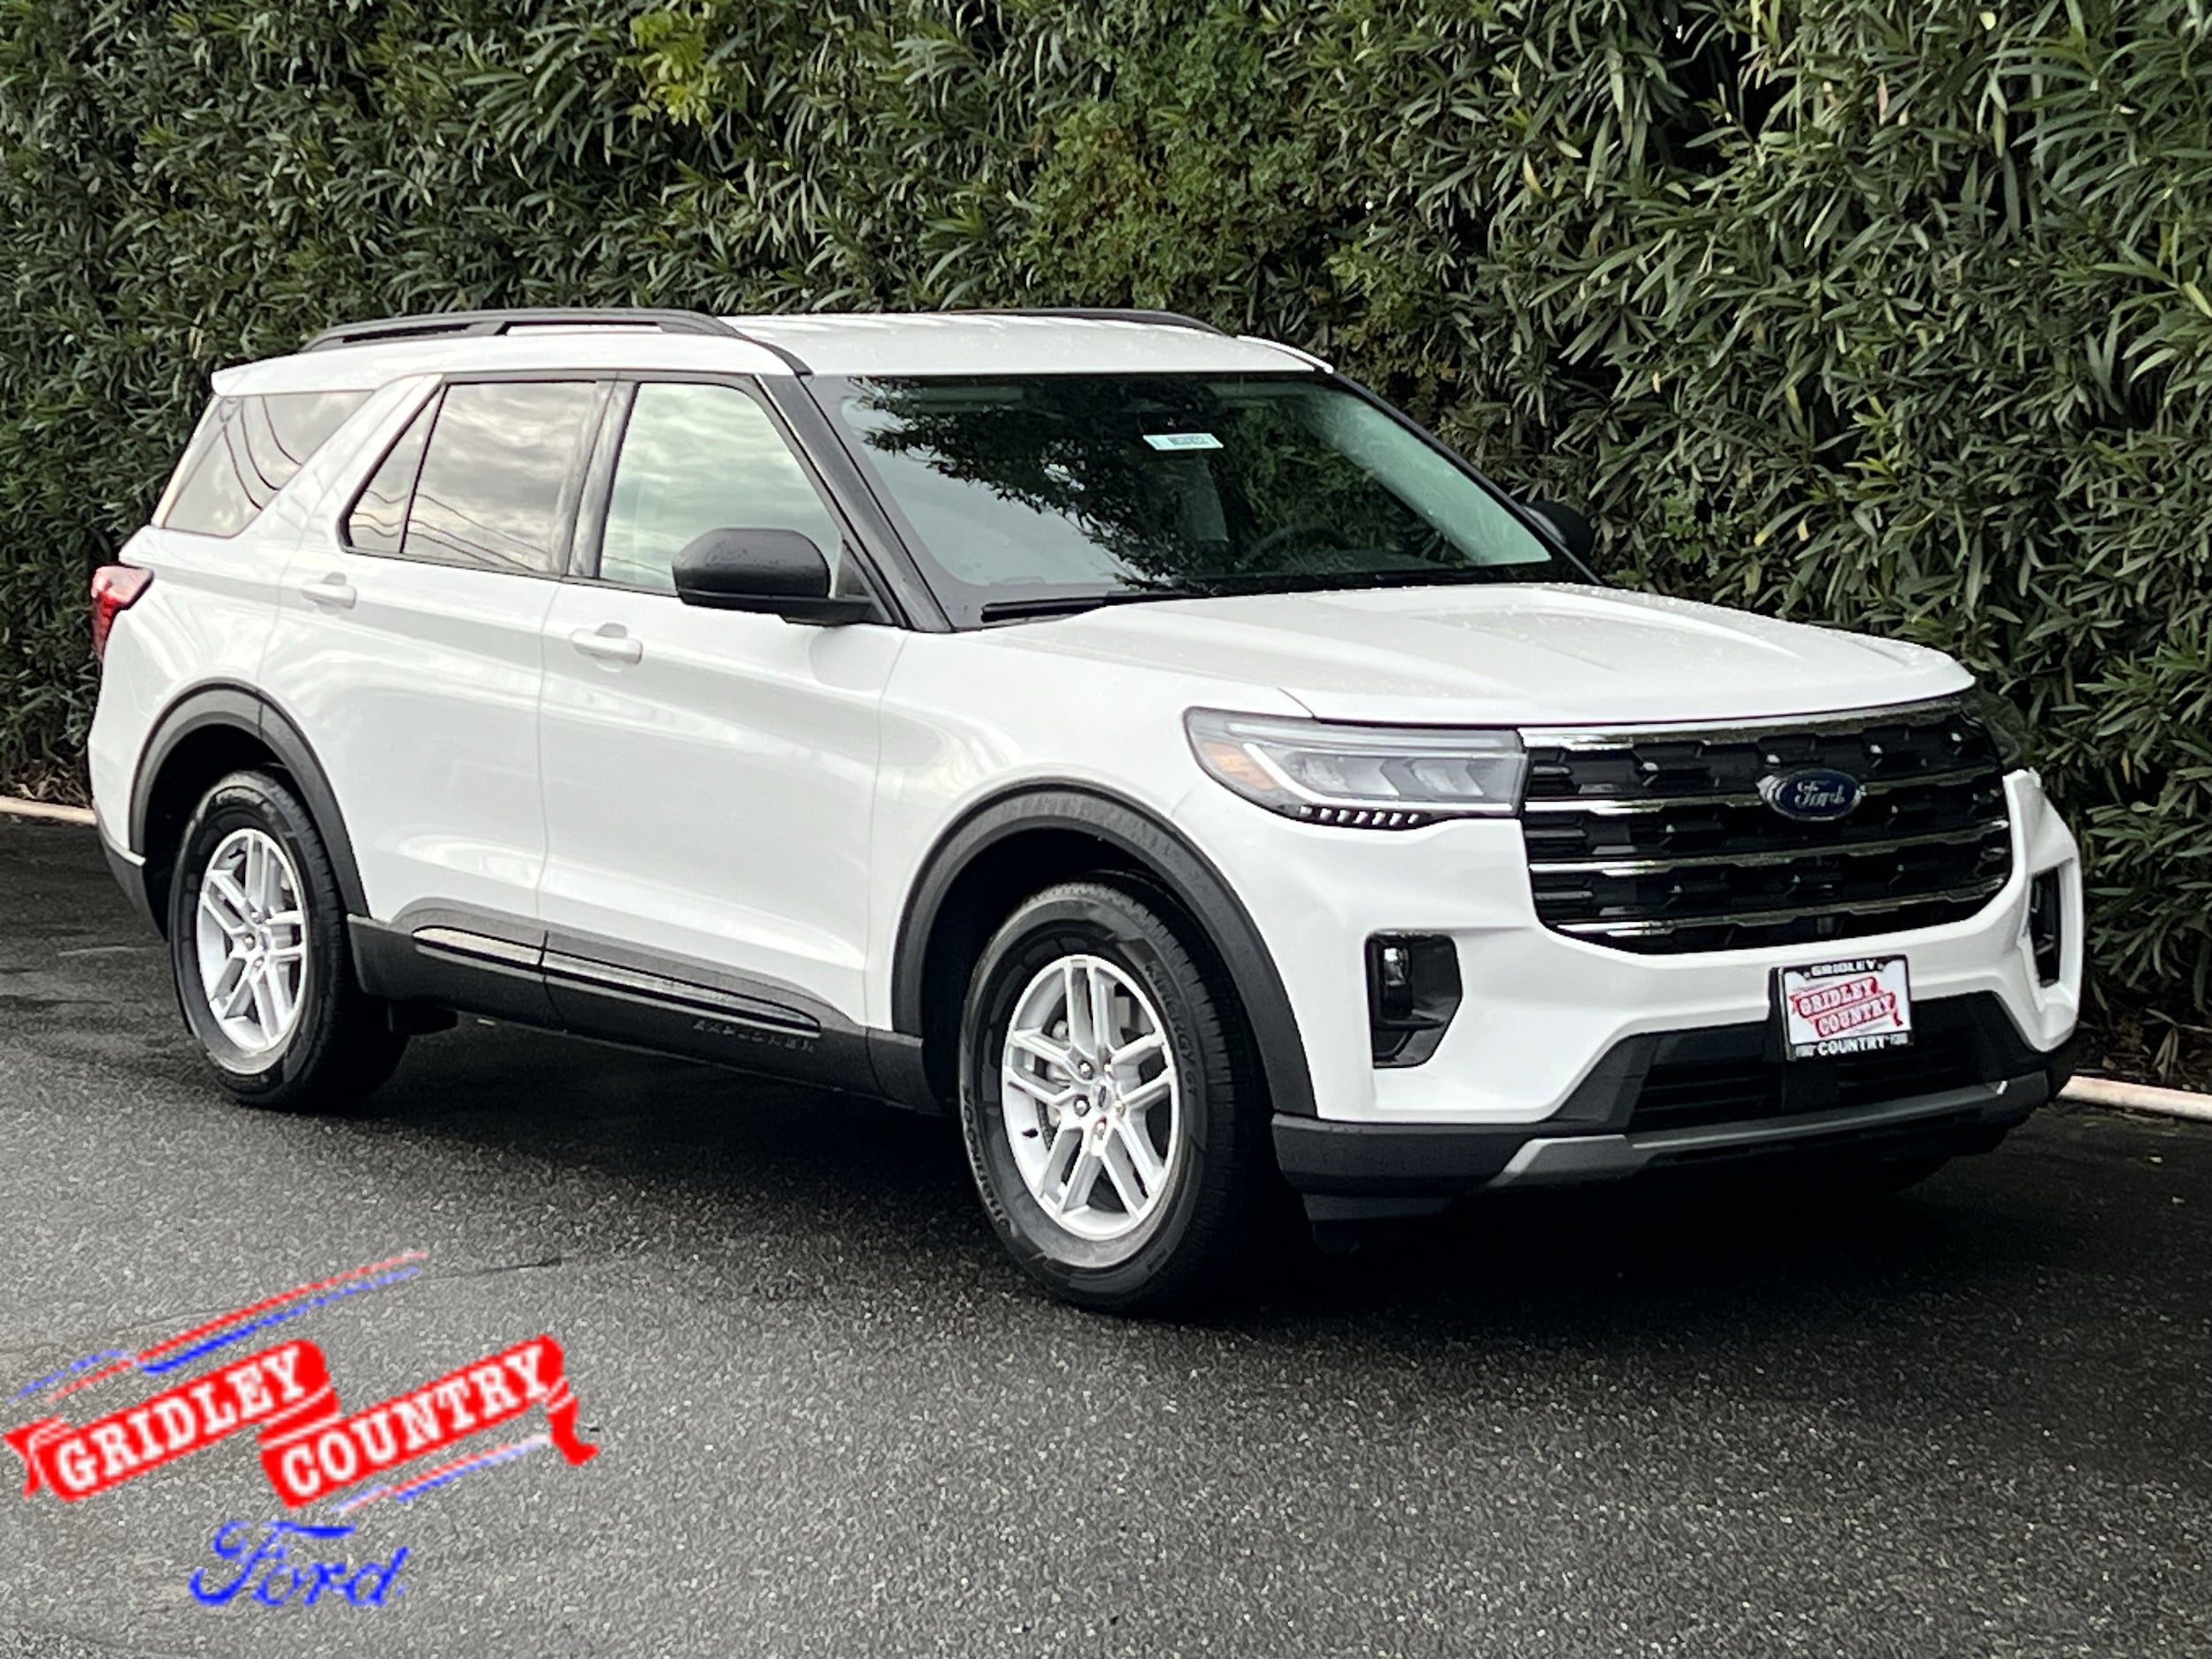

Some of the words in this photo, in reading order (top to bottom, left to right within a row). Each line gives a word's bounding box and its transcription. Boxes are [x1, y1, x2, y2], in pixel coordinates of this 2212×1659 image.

[1794, 780, 1845, 809] Ford
[1811, 959, 1877, 976] GRIDLEY
[1799, 979, 1875, 1017] GRIDLEY
[1818, 996, 1893, 1033] COUNTRY
[1817, 1034, 1886, 1056] COUNTRY
